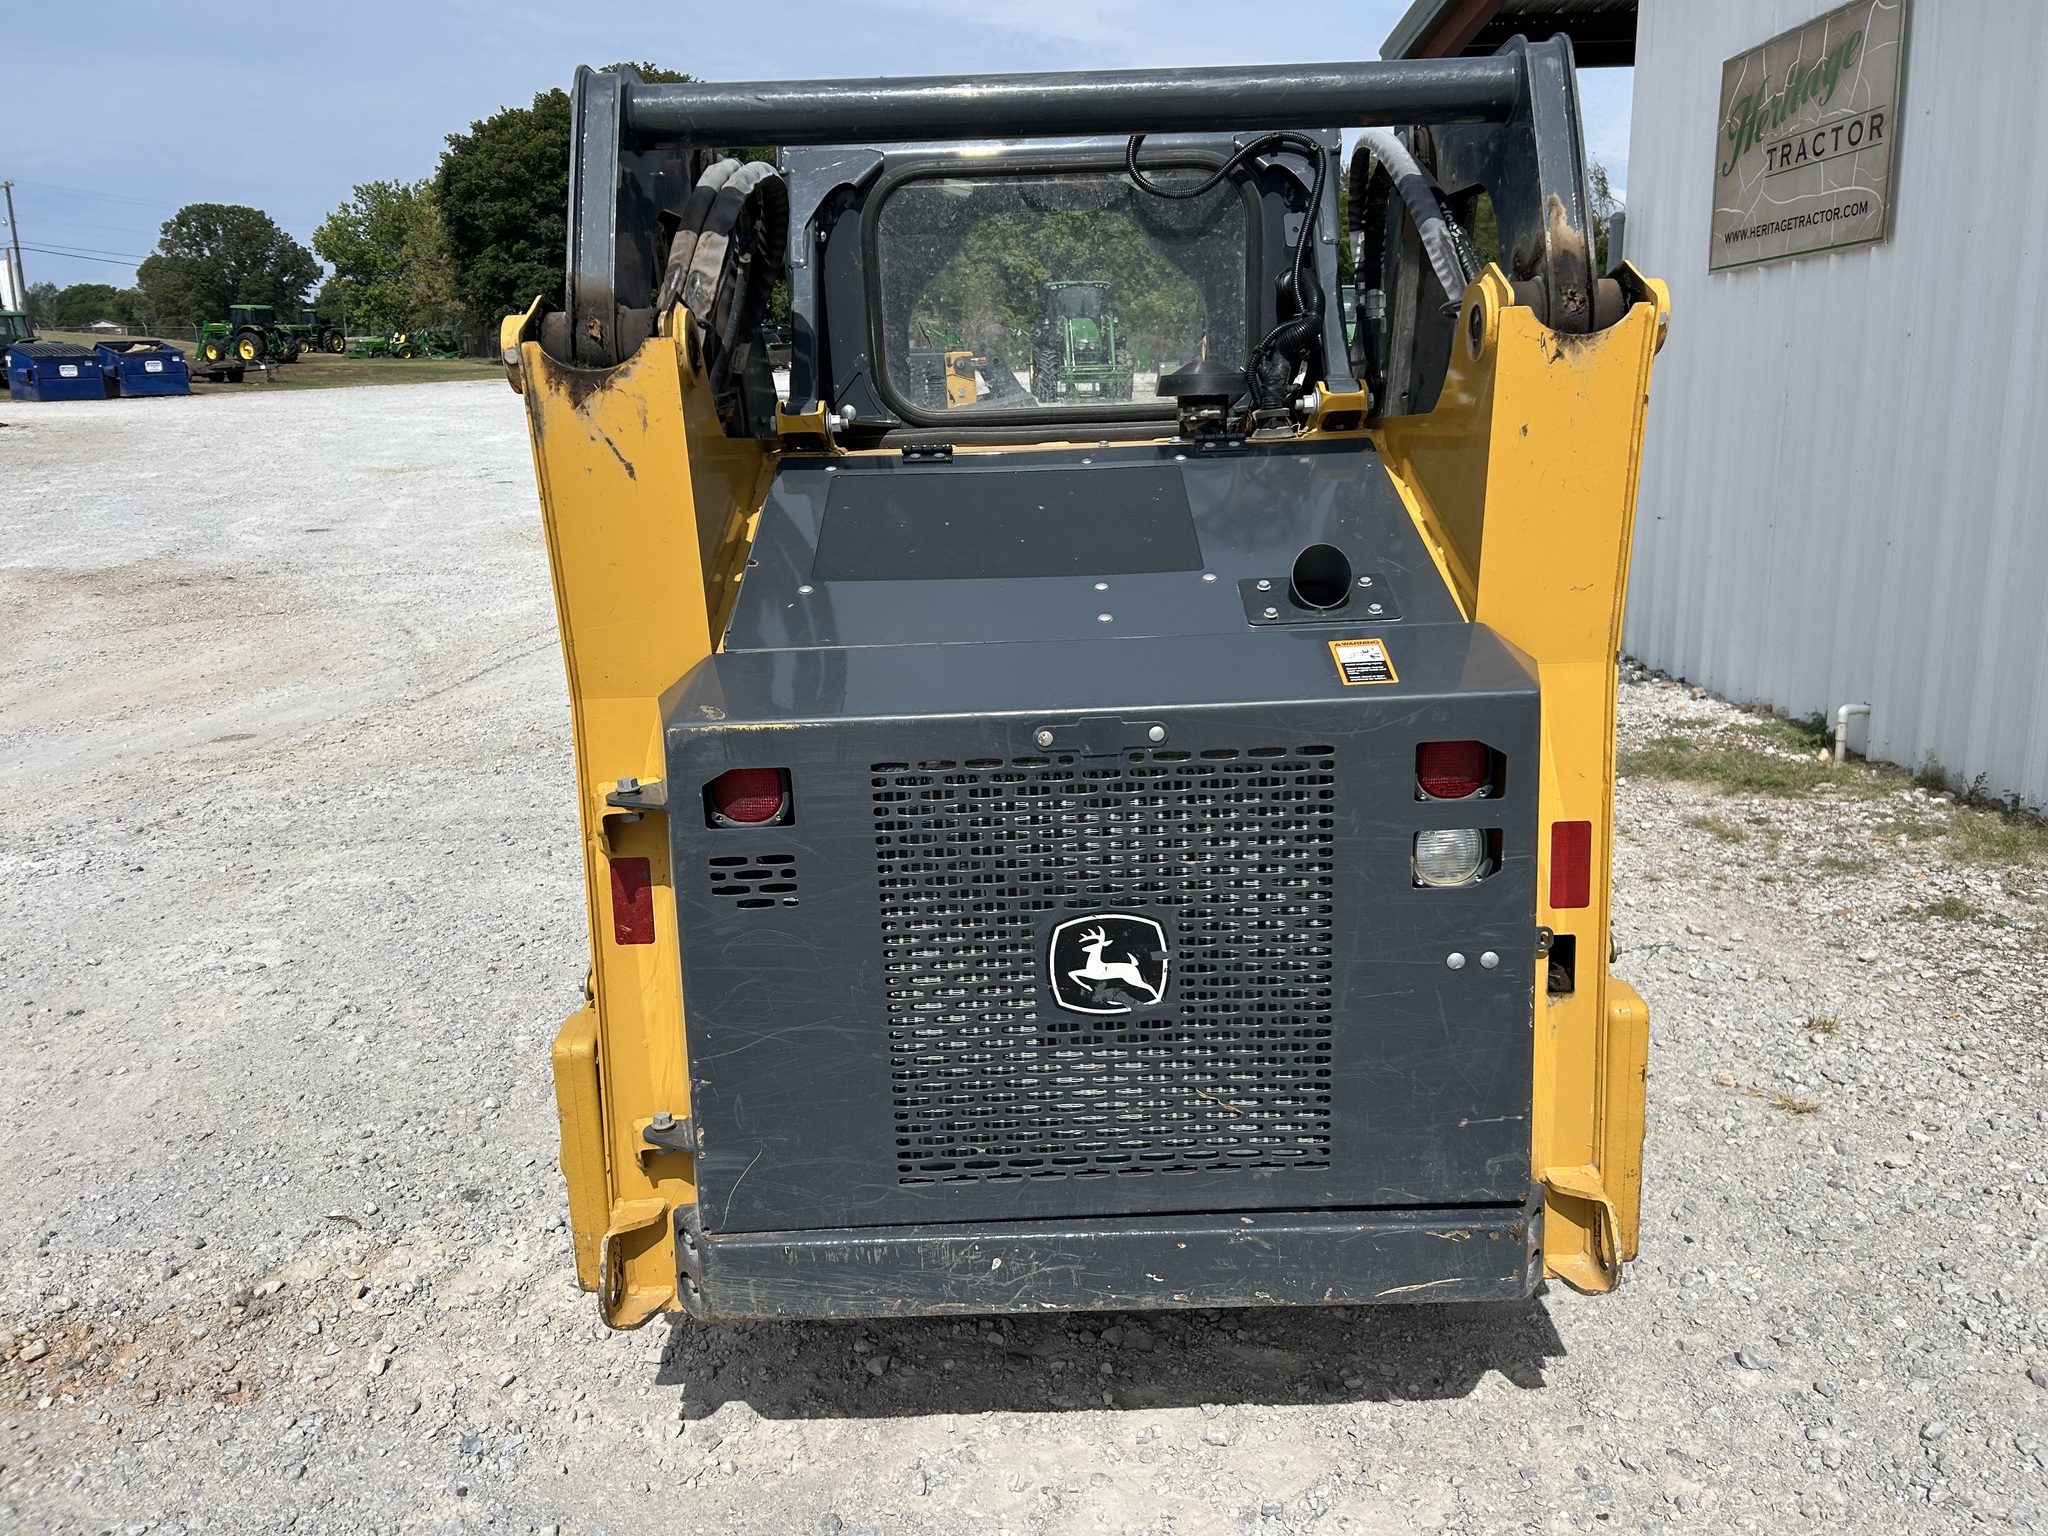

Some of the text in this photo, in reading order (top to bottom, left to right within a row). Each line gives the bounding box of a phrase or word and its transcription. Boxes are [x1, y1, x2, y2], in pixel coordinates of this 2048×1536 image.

[1722, 29, 1862, 177] Heritage
[1766, 113, 1884, 171] TRACTOR
[1724, 200, 1868, 244] WWW.HERITAGETRACTOR.COM
